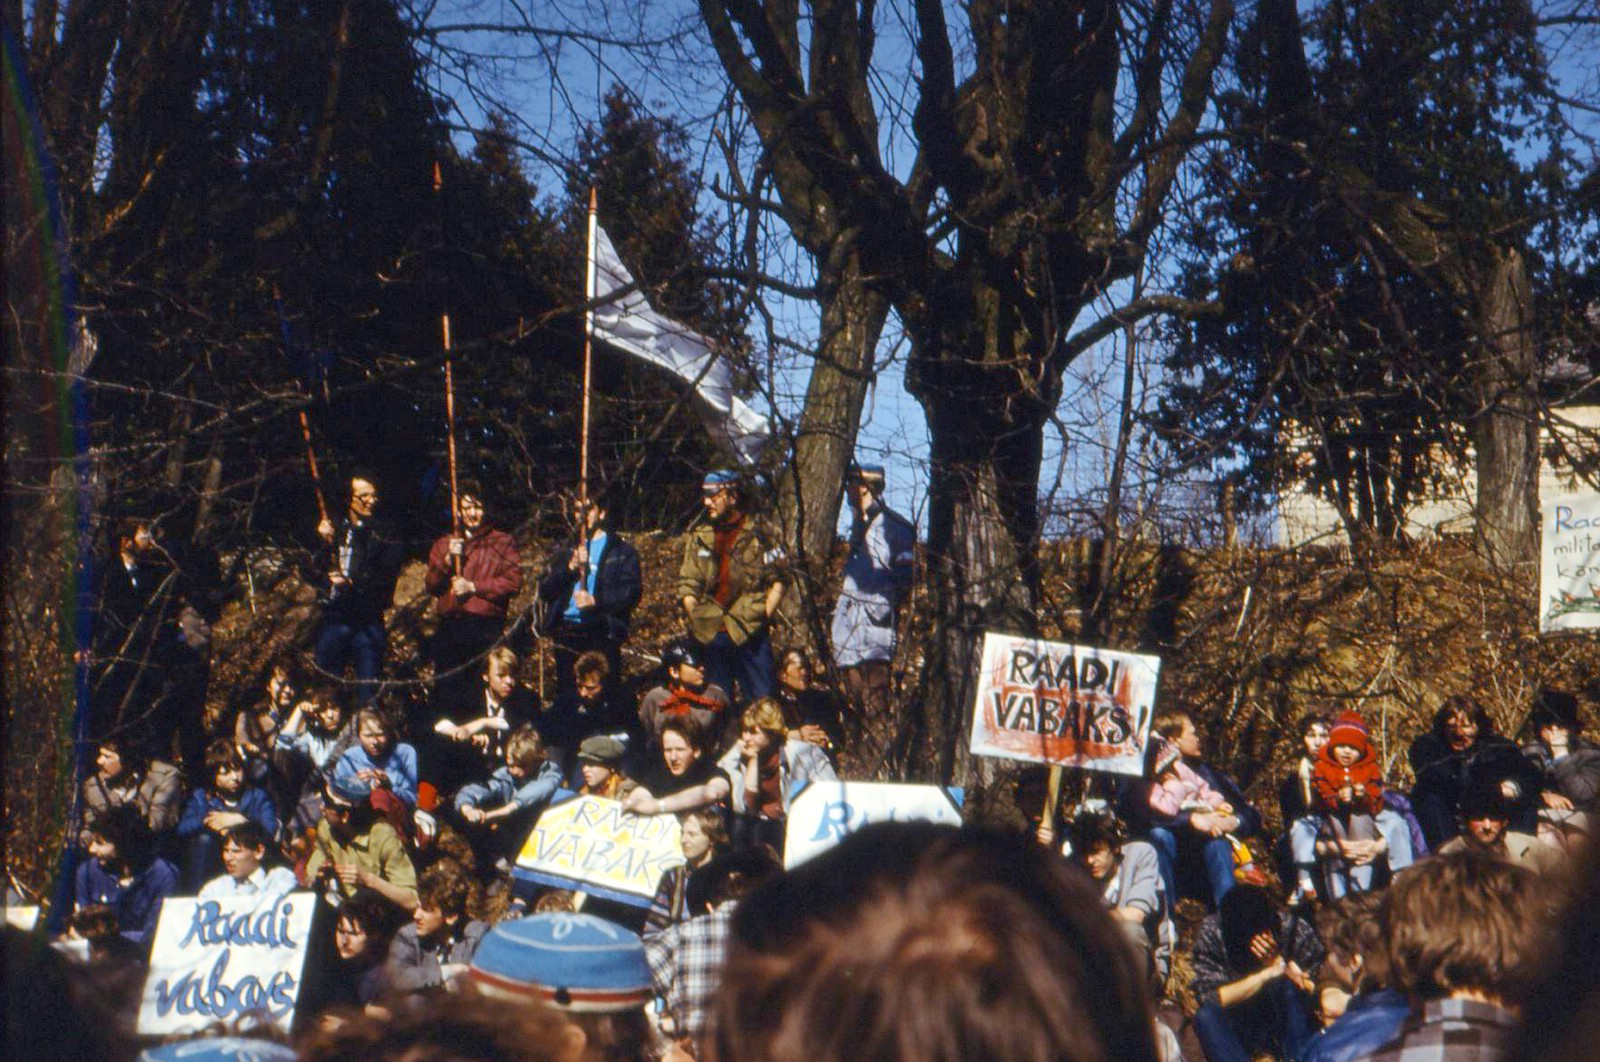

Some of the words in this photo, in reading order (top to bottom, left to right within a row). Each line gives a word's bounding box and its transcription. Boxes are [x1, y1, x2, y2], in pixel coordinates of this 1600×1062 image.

[1010, 649, 1120, 695] RAADI
[993, 691, 1149, 748] VABAKS!
[178, 896, 297, 949] Raadi
